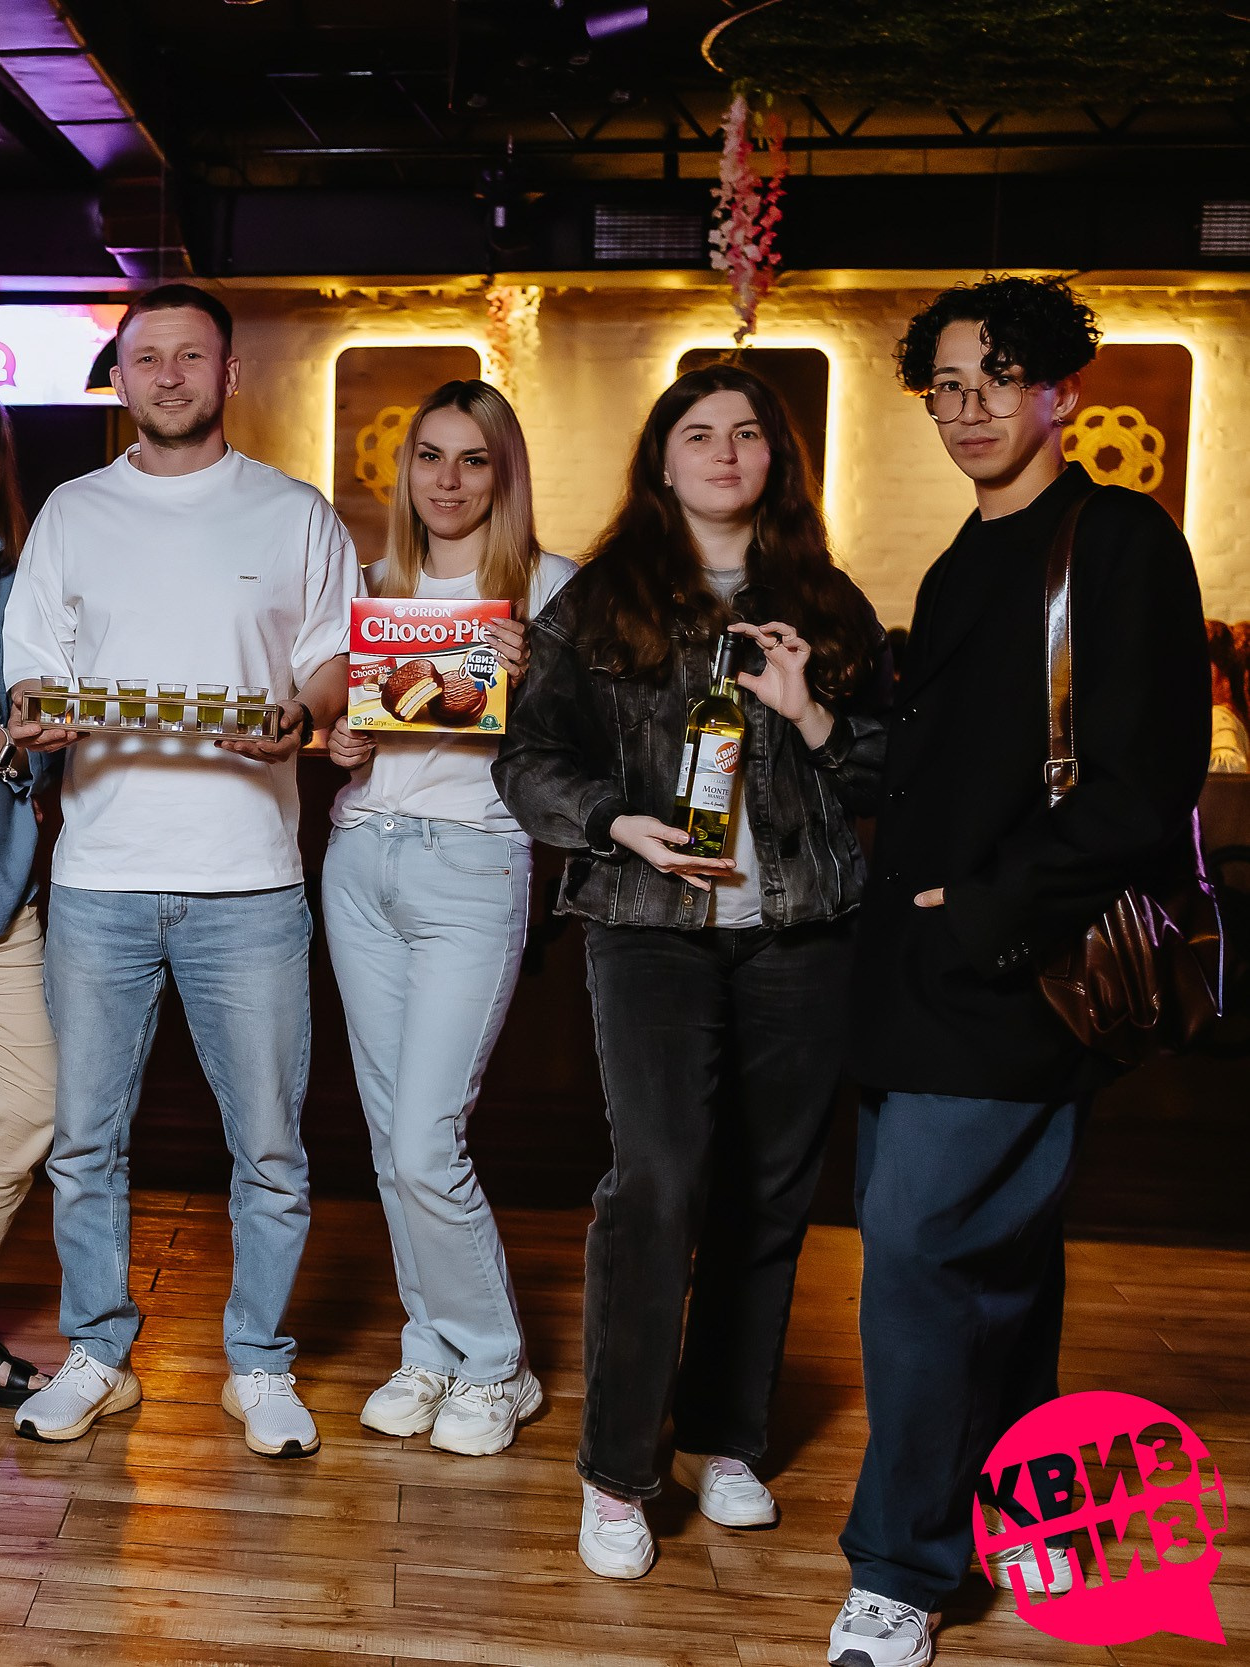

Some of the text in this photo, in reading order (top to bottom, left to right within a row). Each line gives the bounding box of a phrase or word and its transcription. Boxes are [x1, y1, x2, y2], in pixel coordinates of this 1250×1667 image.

[408, 607, 450, 617] ORION
[363, 717, 373, 726] 12
[702, 785, 730, 796] MONTE
